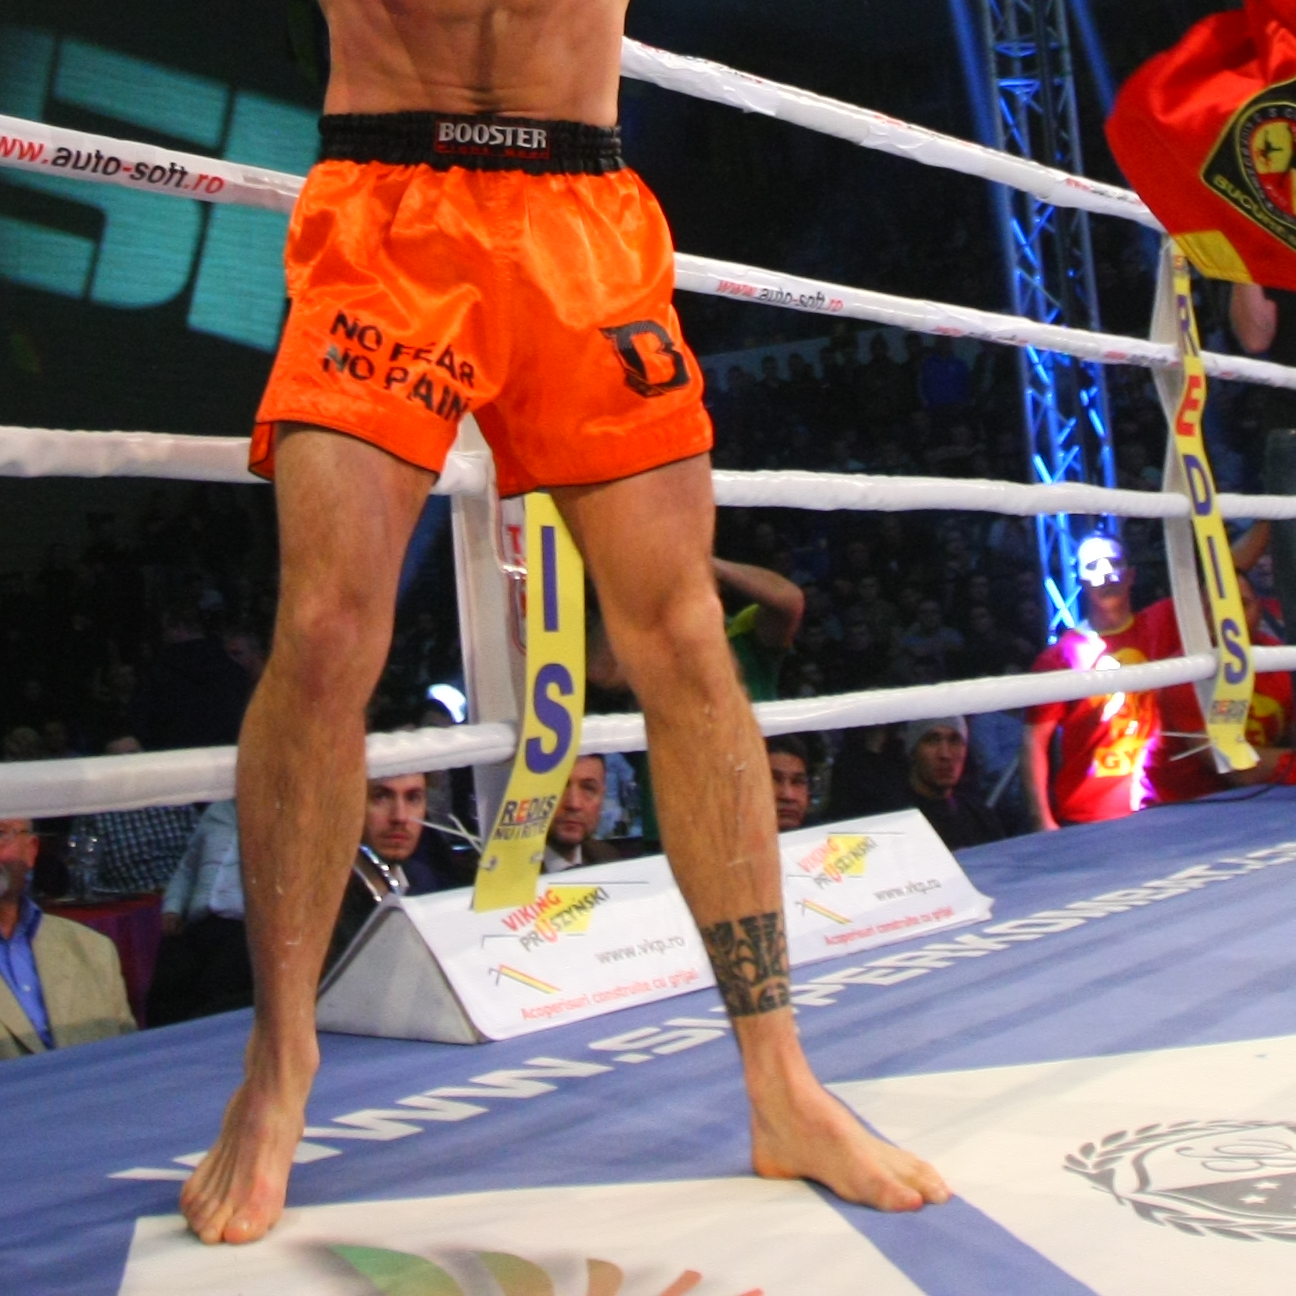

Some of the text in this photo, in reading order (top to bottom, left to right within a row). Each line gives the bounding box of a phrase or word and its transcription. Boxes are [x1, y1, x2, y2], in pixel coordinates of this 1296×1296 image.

[438, 122, 548, 149] BOOSTER
[330, 309, 475, 389] NO FEAR
[322, 344, 471, 422] NO PAIN
[501, 888, 563, 932] VIKING
[594, 935, 686, 965] www.vkp.ro
